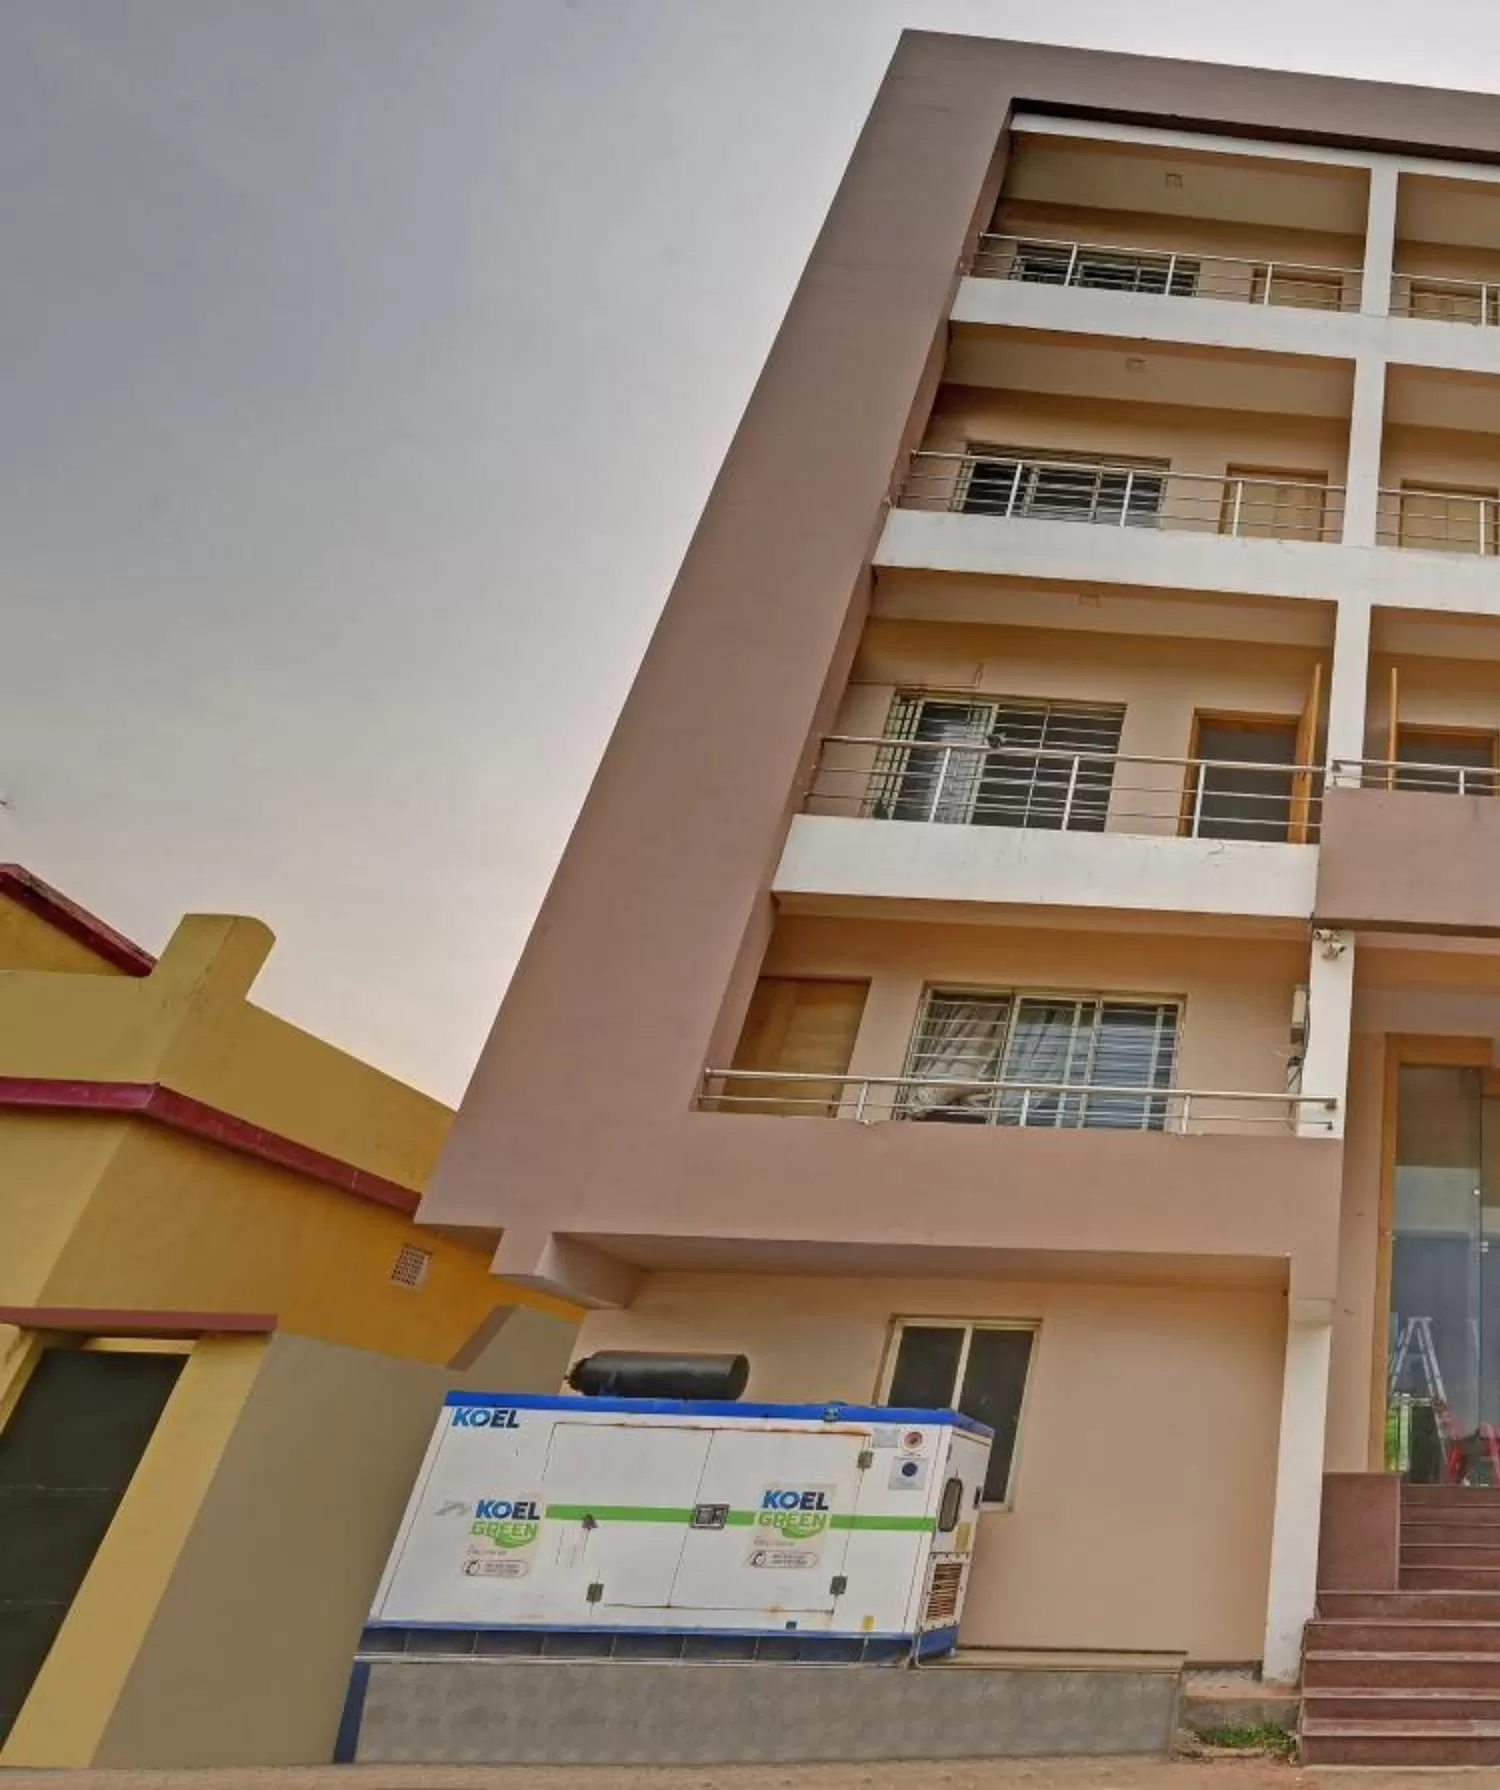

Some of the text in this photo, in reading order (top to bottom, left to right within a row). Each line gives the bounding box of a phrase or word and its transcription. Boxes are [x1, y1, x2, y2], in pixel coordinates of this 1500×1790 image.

[452, 1407, 520, 1428] KOEL
[475, 1499, 540, 1520] KOEL
[762, 1490, 829, 1510] KOEL
[471, 1521, 538, 1537] GREEN
[758, 1511, 827, 1528] GREEN
